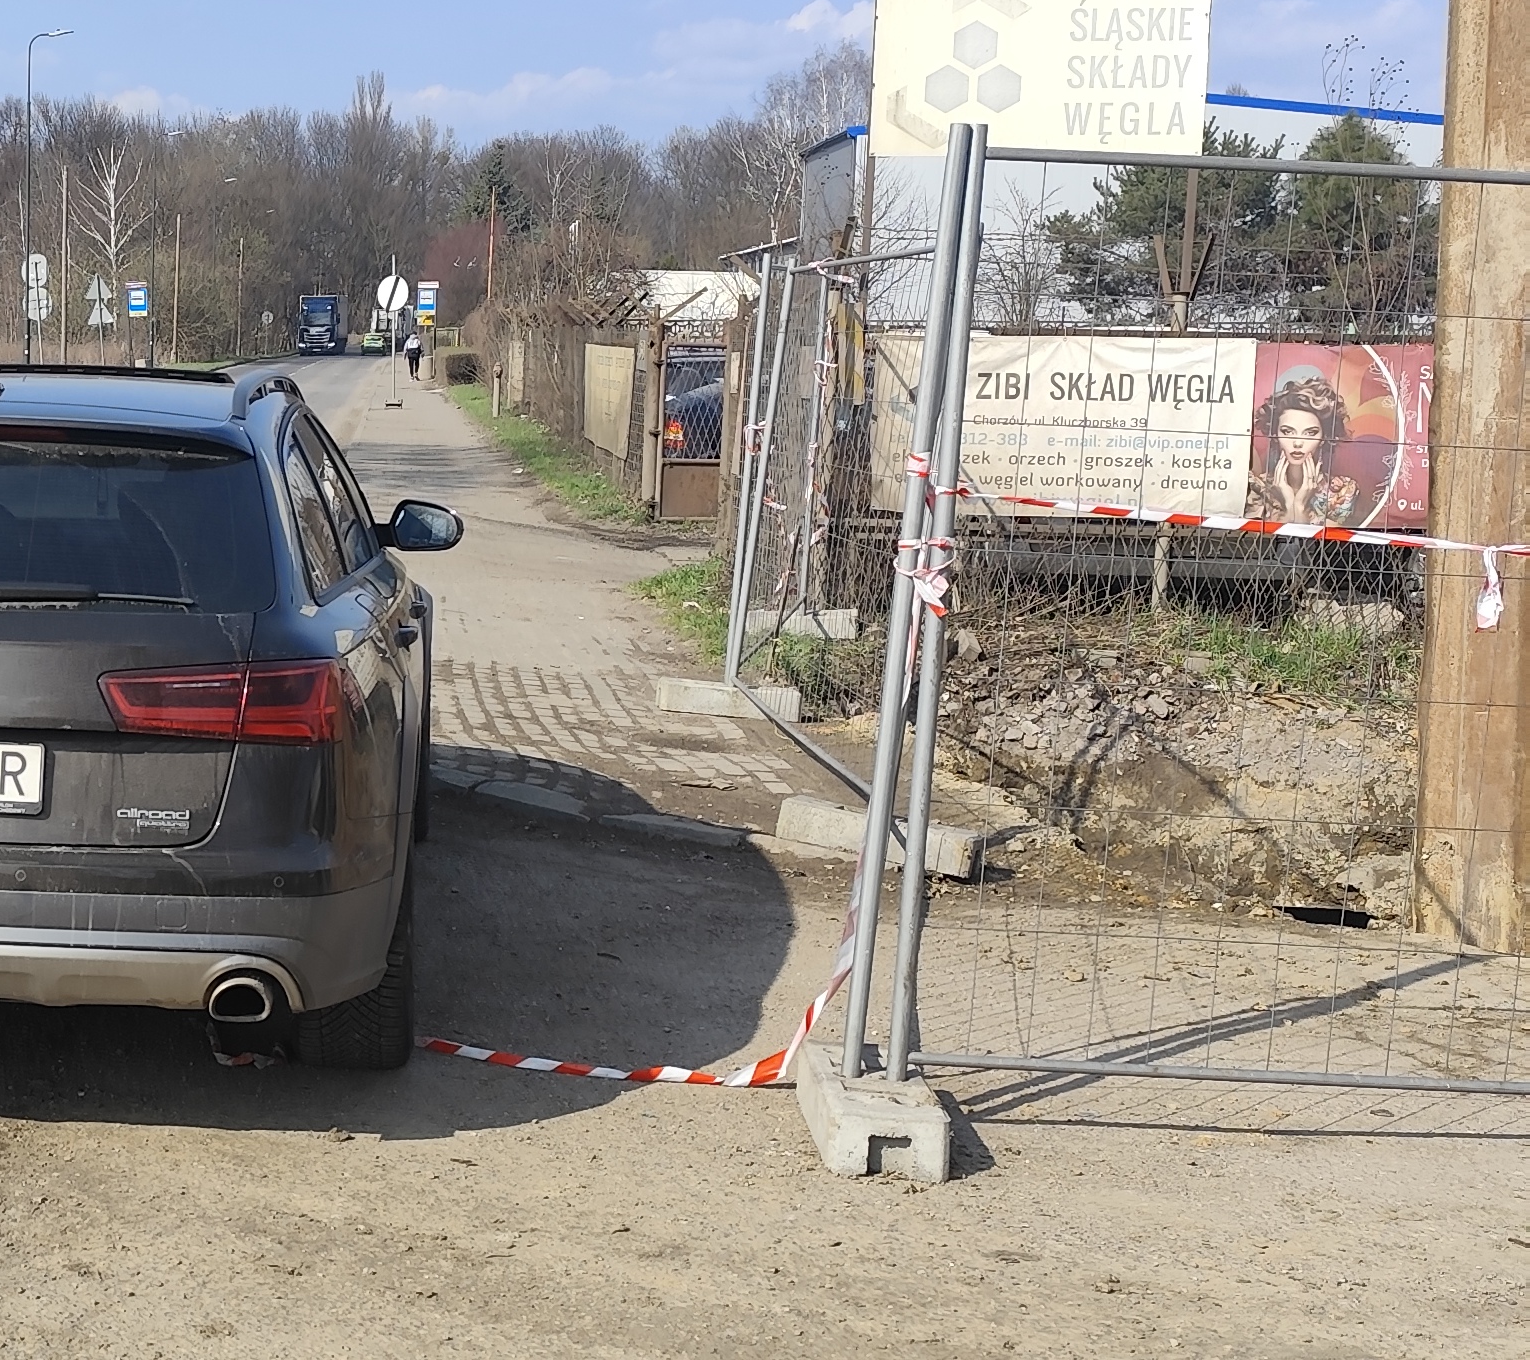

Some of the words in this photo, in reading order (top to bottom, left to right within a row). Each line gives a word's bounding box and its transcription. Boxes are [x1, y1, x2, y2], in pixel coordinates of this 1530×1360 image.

[1070, 0, 1194, 50] ŚLĄSKIE
[1067, 55, 1192, 88] SKŁADY
[1064, 102, 1185, 144] WĘGLA
[976, 372, 1030, 400] ZIBI
[1049, 372, 1134, 401] SKŁAD
[1148, 373, 1234, 410] WĘGLA
[1053, 416, 1126, 428] Kluczborska
[1130, 418, 1147, 428] 39
[1047, 434, 1100, 448] e-mail:
[1008, 451, 1065, 466] orzech
[1084, 454, 1153, 470] groszek
[1171, 454, 1232, 469] kostka
[978, 472, 1033, 489] węgiel
[1040, 472, 1142, 492] workowany
[1161, 475, 1228, 490] drewno
[116, 808, 189, 820] allroad
